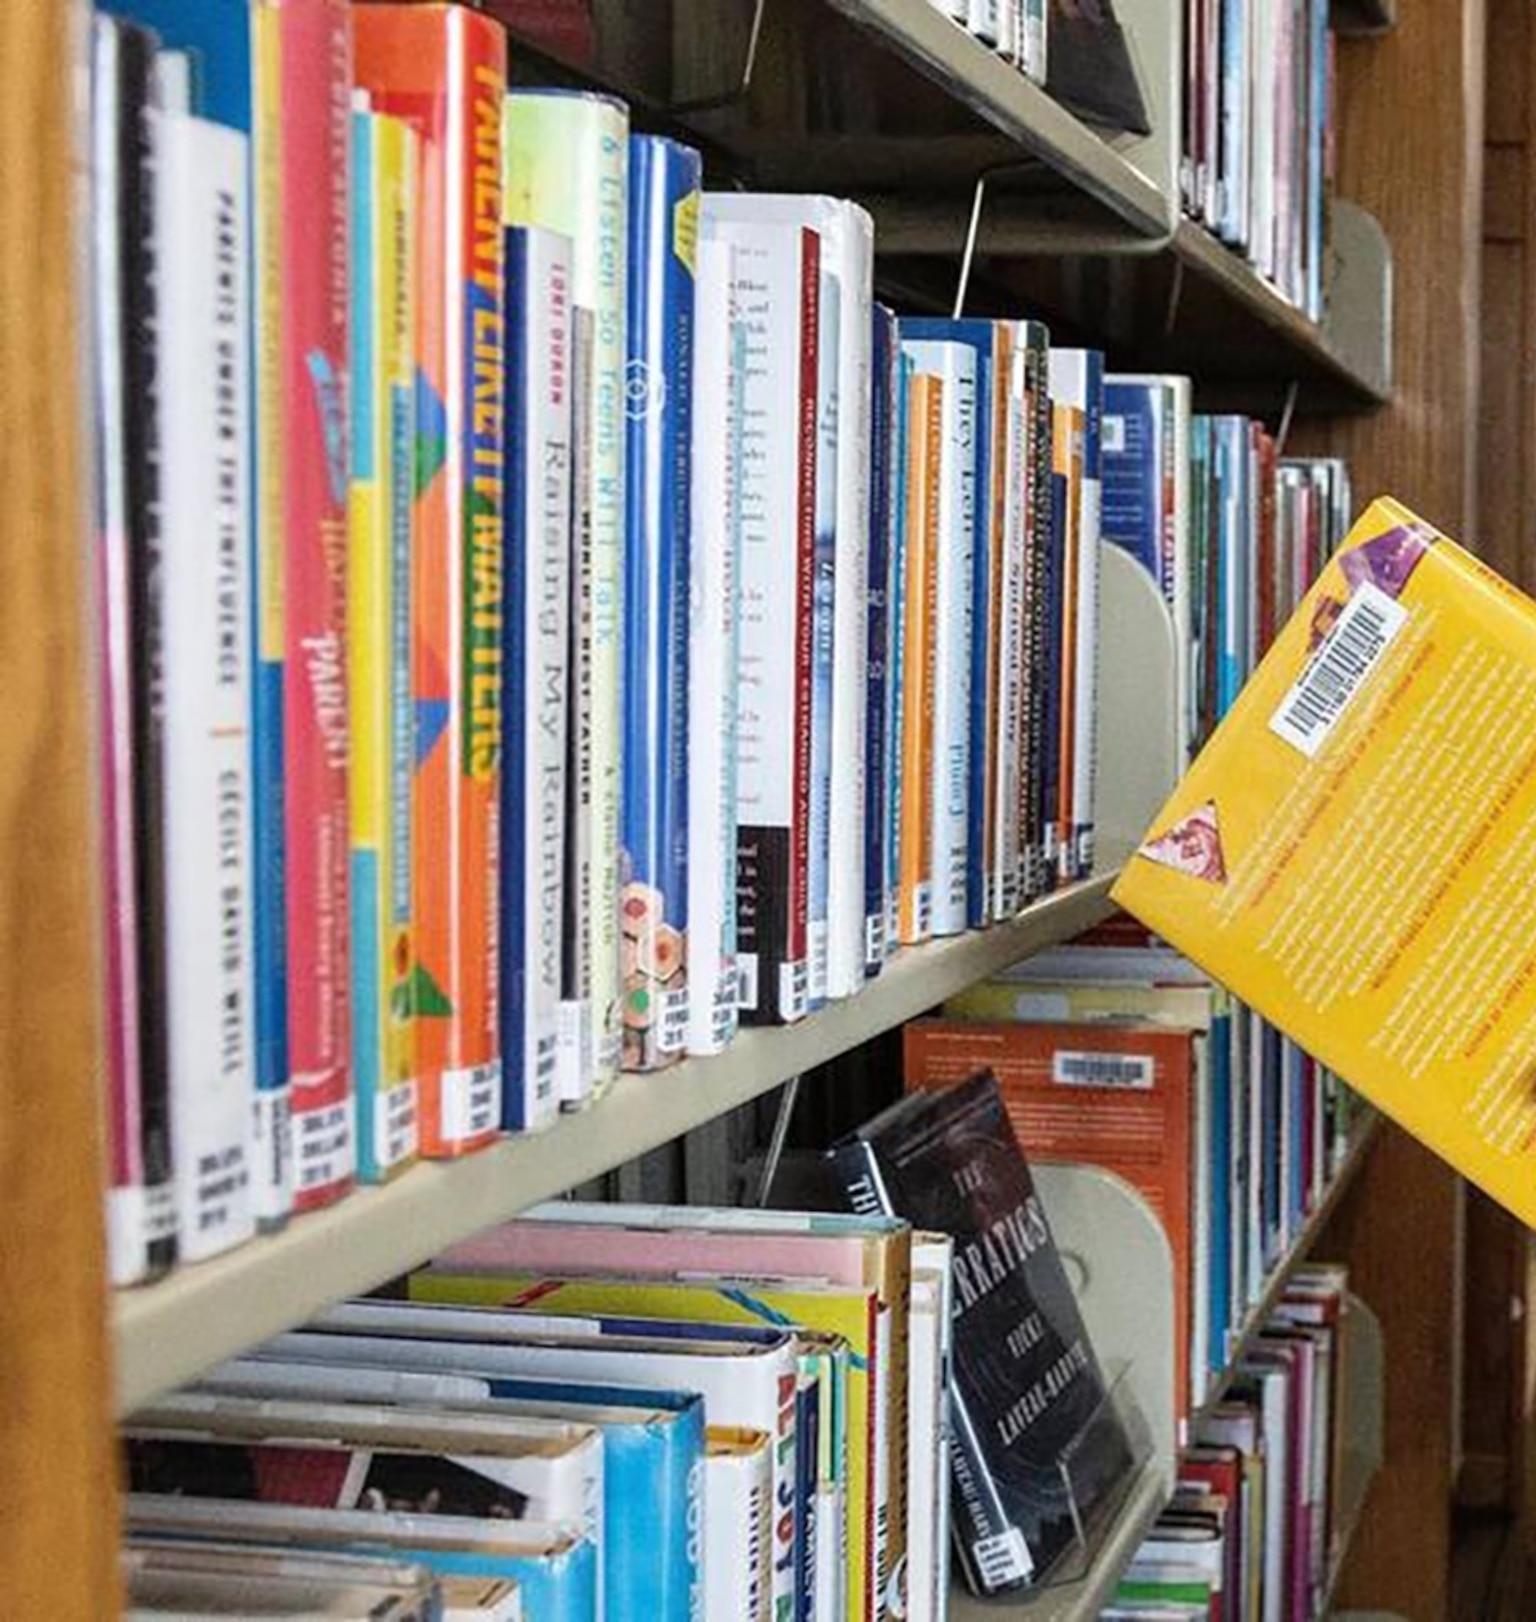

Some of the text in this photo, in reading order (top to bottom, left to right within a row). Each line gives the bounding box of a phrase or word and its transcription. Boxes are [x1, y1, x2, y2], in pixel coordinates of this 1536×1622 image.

[601, 177, 620, 287] Listen
[551, 264, 566, 406] LORI DURON
[602, 309, 617, 344] So
[218, 192, 236, 684] PARENTS UNDER THE INFLUENCE
[473, 66, 503, 783] PARENT LIKE IT MATTERS
[601, 370, 617, 455] Teens
[952, 375, 974, 448] They
[598, 477, 620, 545] Will
[802, 398, 815, 549] RECONNECTING
[582, 511, 592, 624] WORLD'S
[597, 573, 617, 645] Talk
[801, 557, 812, 607] WITH
[581, 638, 592, 697] BEST
[800, 615, 811, 666] YOUR
[301, 632, 347, 768] PARENT
[538, 441, 566, 986] Raising My Rainbow
[581, 711, 592, 805] FATHER
[220, 771, 241, 1076] CÉCILE DAVID WEILL
[776, 1373, 796, 1572] ALL JOY
